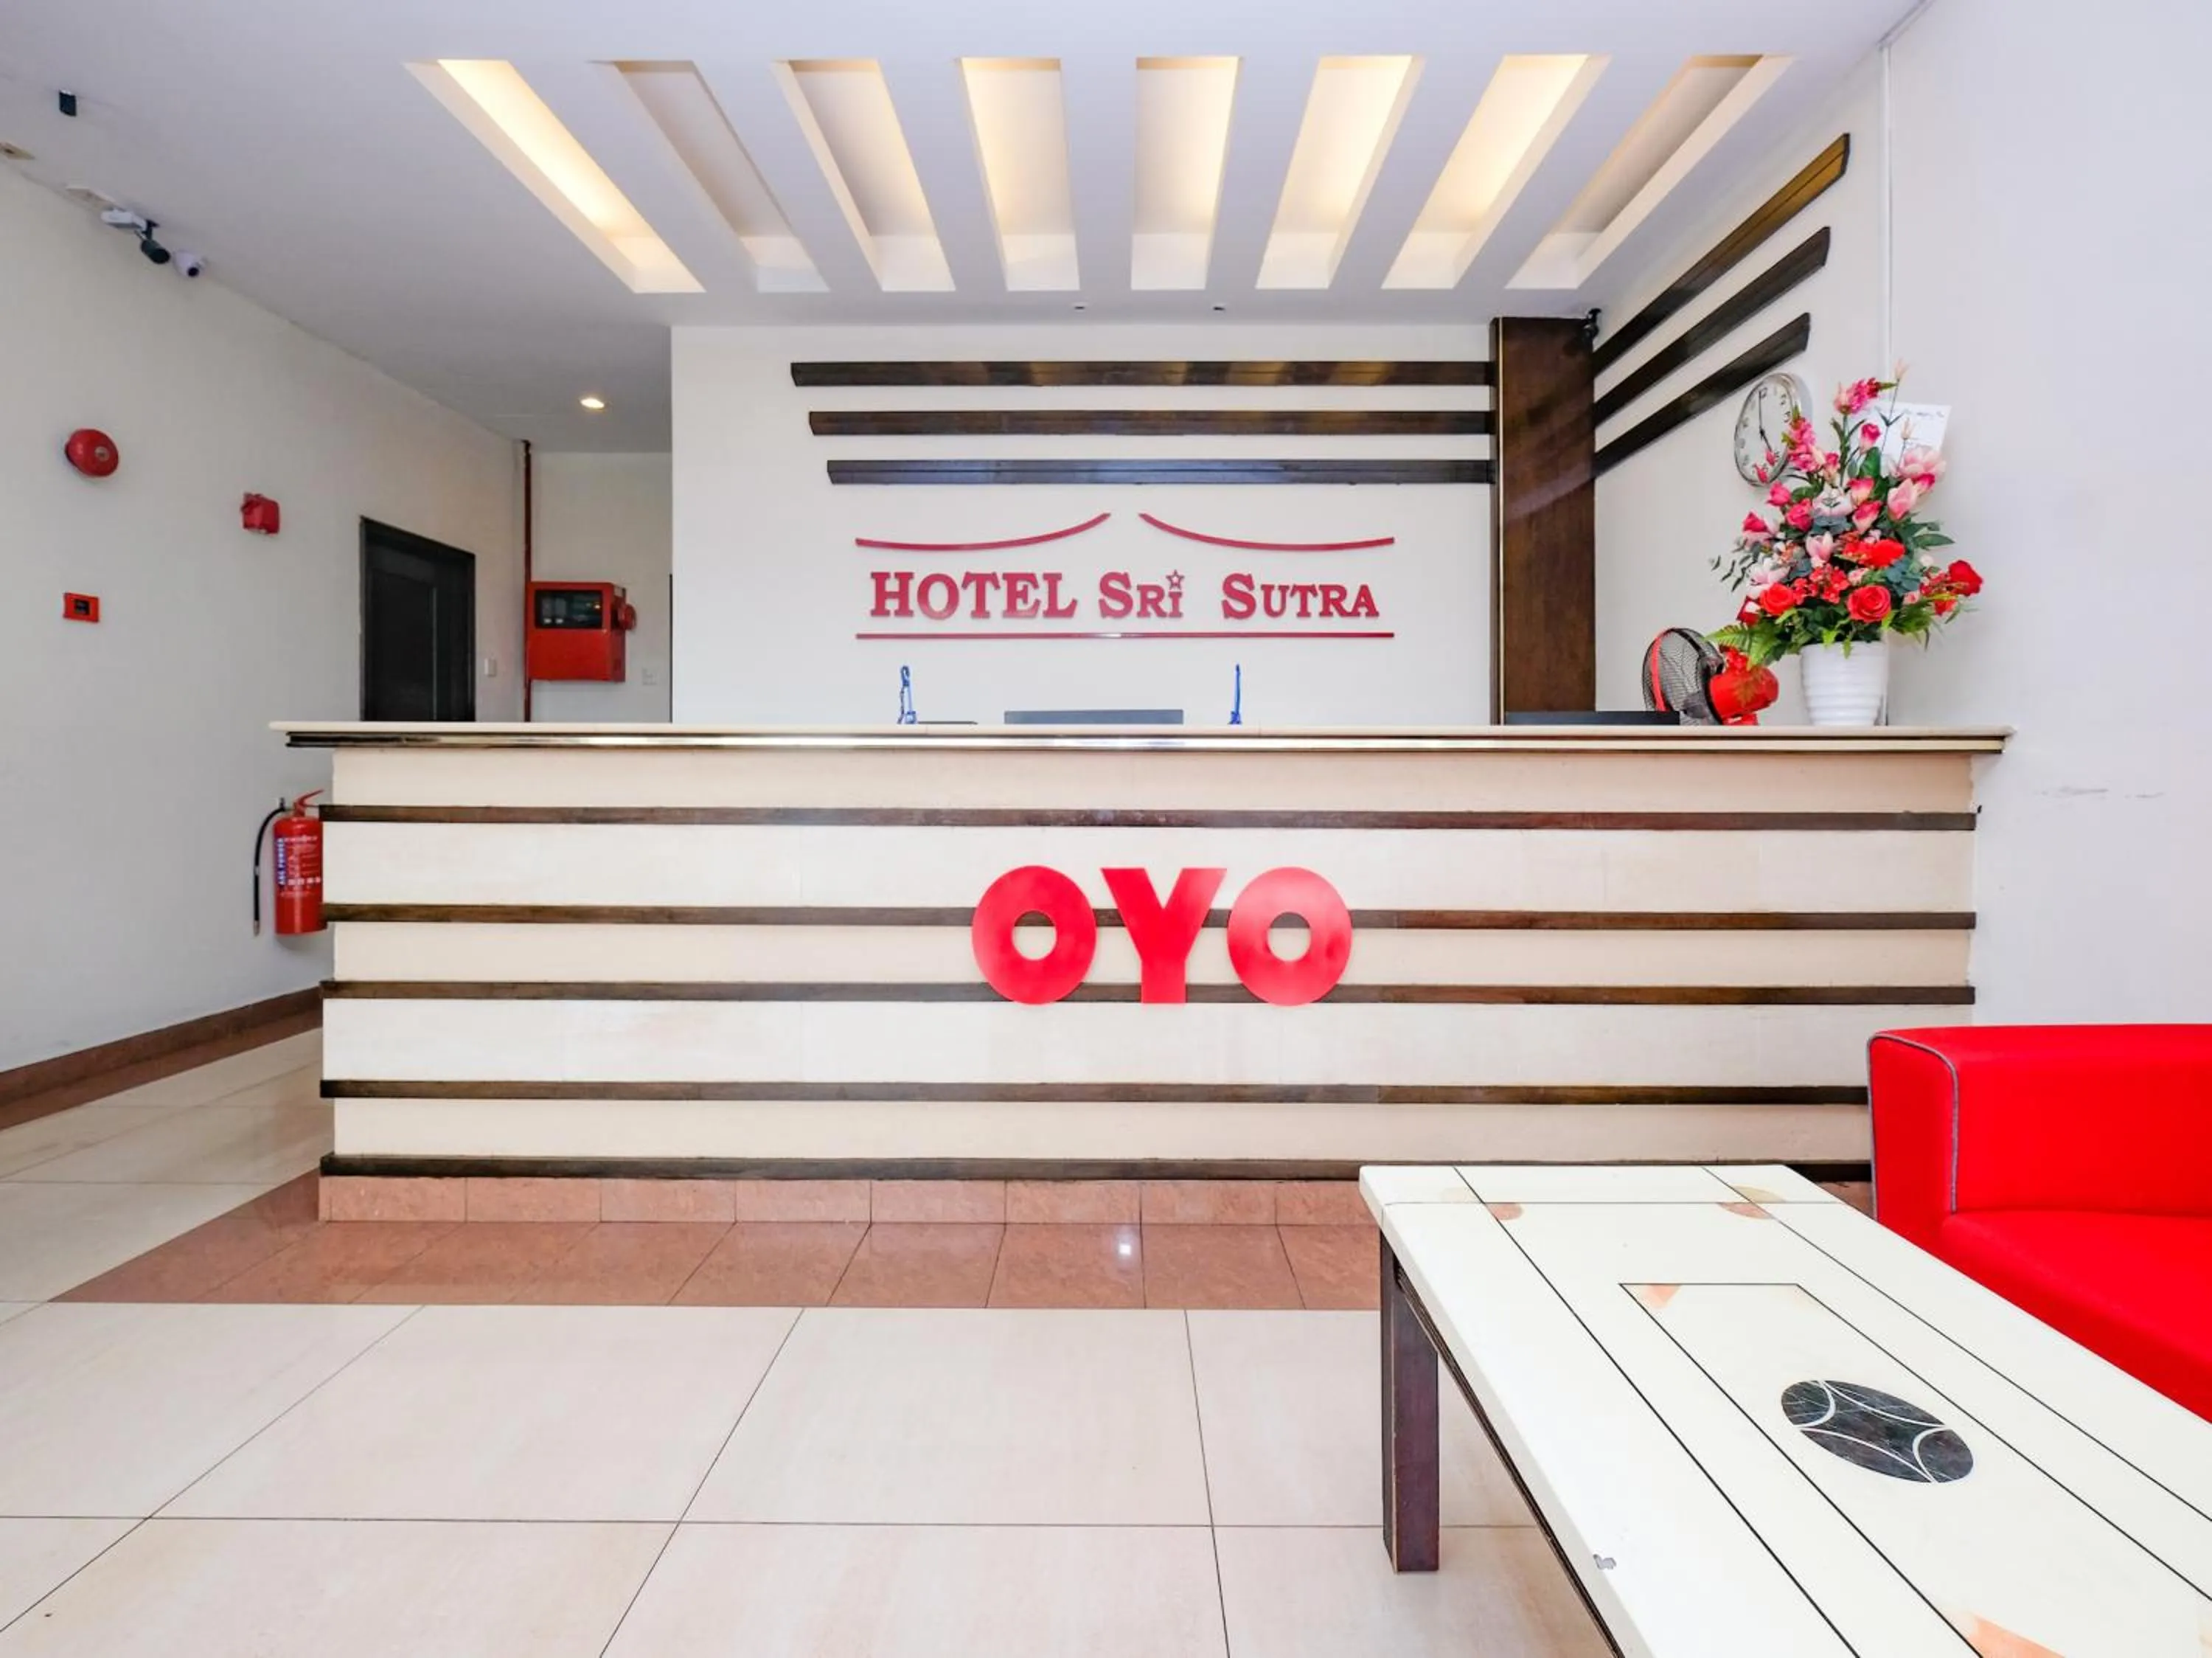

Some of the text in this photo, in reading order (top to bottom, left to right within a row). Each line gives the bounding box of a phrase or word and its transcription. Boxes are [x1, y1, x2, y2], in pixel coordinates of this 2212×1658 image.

[870, 572, 1077, 619] HOTEL
[1222, 572, 1380, 619] SUTRA
[971, 865, 1354, 1006] OYO
